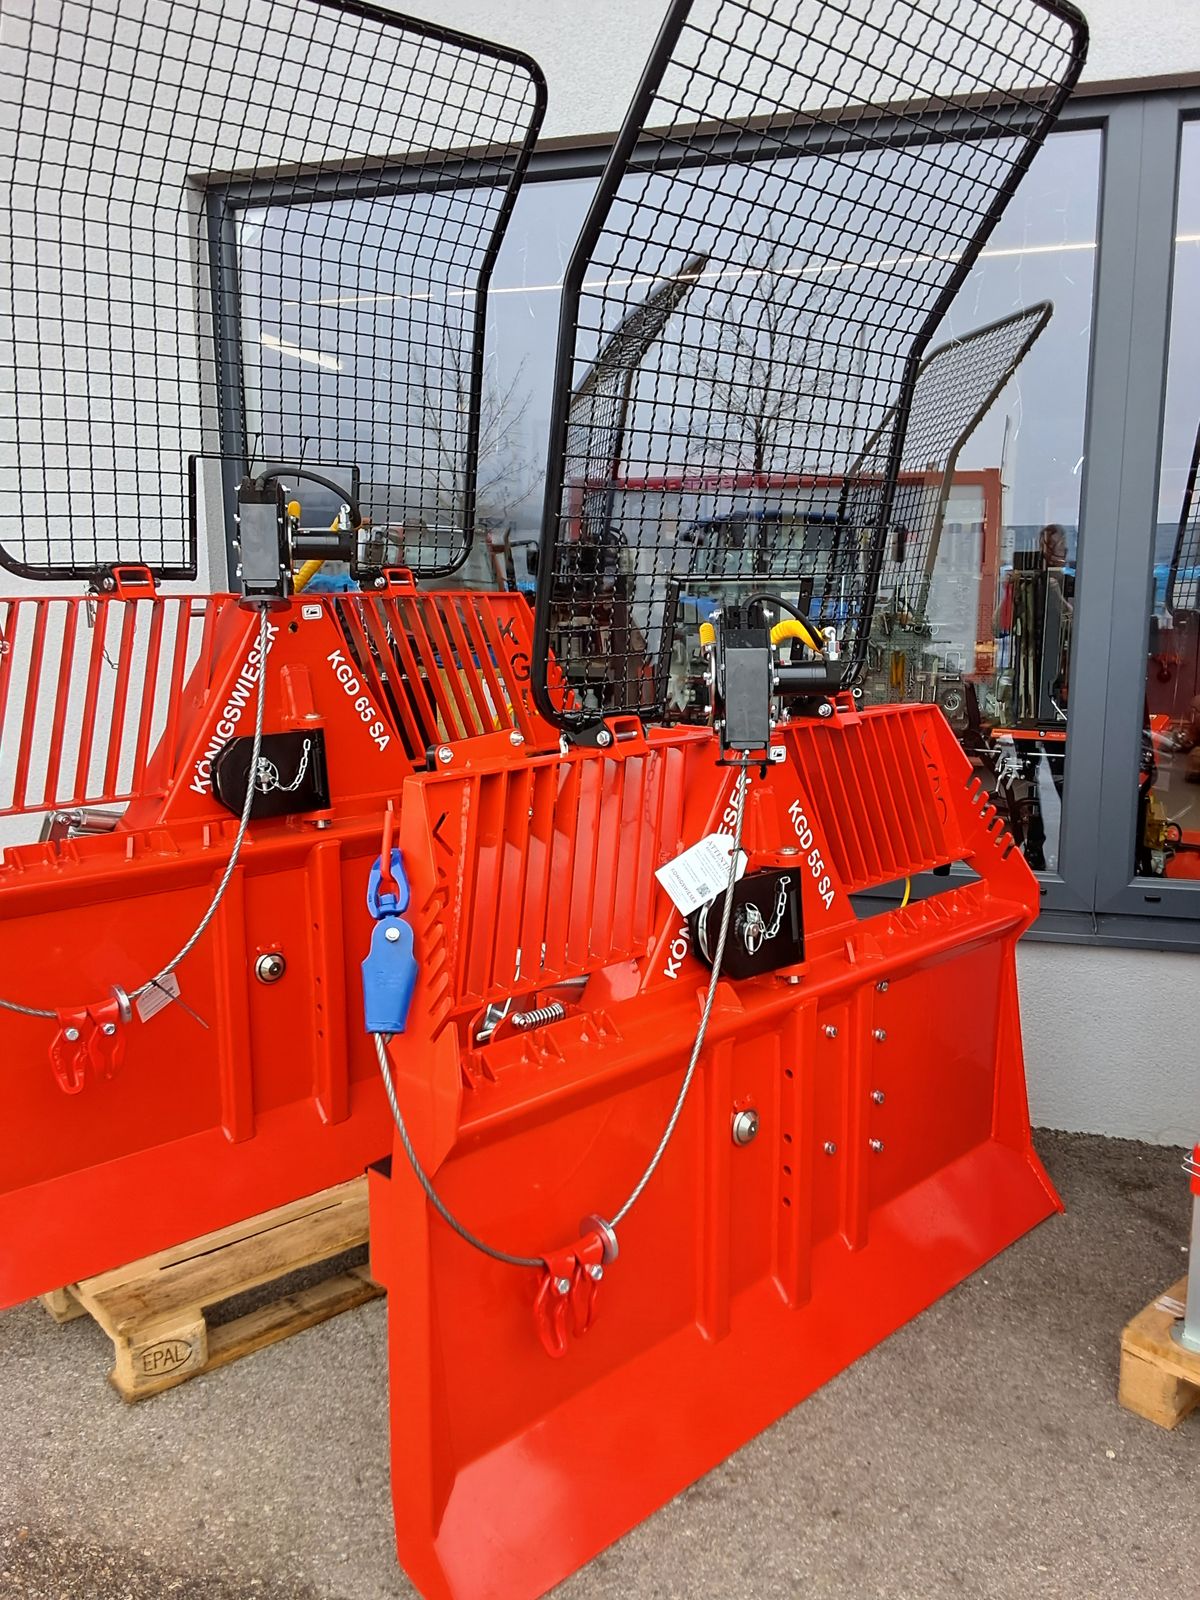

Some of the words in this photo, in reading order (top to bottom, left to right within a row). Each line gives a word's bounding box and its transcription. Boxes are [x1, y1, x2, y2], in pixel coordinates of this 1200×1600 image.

[326, 648, 361, 697] KGD
[354, 695, 376, 723] 65
[368, 720, 392, 752] SA
[787, 799, 814, 850] KGD
[806, 848, 823, 879] 55
[817, 877, 836, 910] SA
[142, 1345, 185, 1372] EPAL
